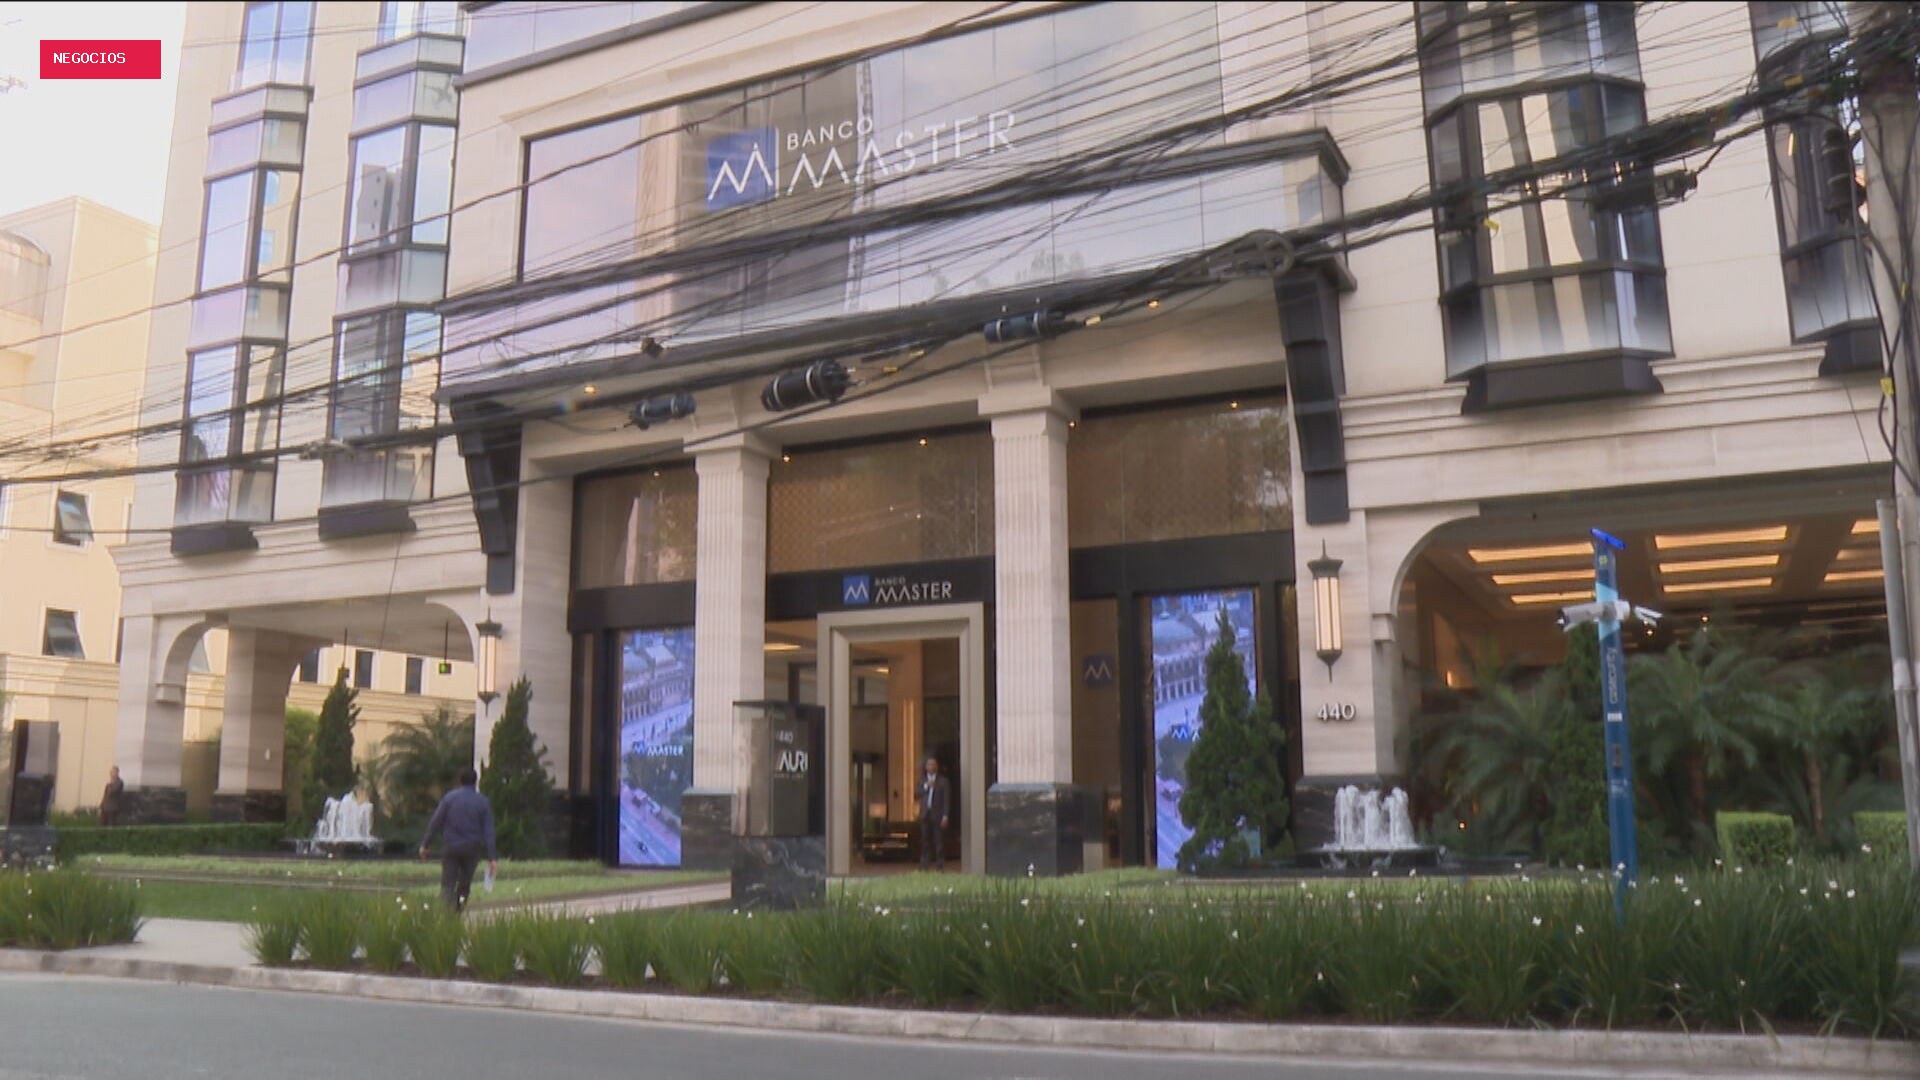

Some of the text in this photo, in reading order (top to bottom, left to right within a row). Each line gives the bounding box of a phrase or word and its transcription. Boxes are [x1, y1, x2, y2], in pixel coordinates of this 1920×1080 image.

[786, 117, 873, 151] BANCO
[787, 110, 1016, 195] MASTER
[875, 581, 953, 603] MASTER
[1318, 702, 1356, 721] 440
[647, 744, 684, 757] MASTER
